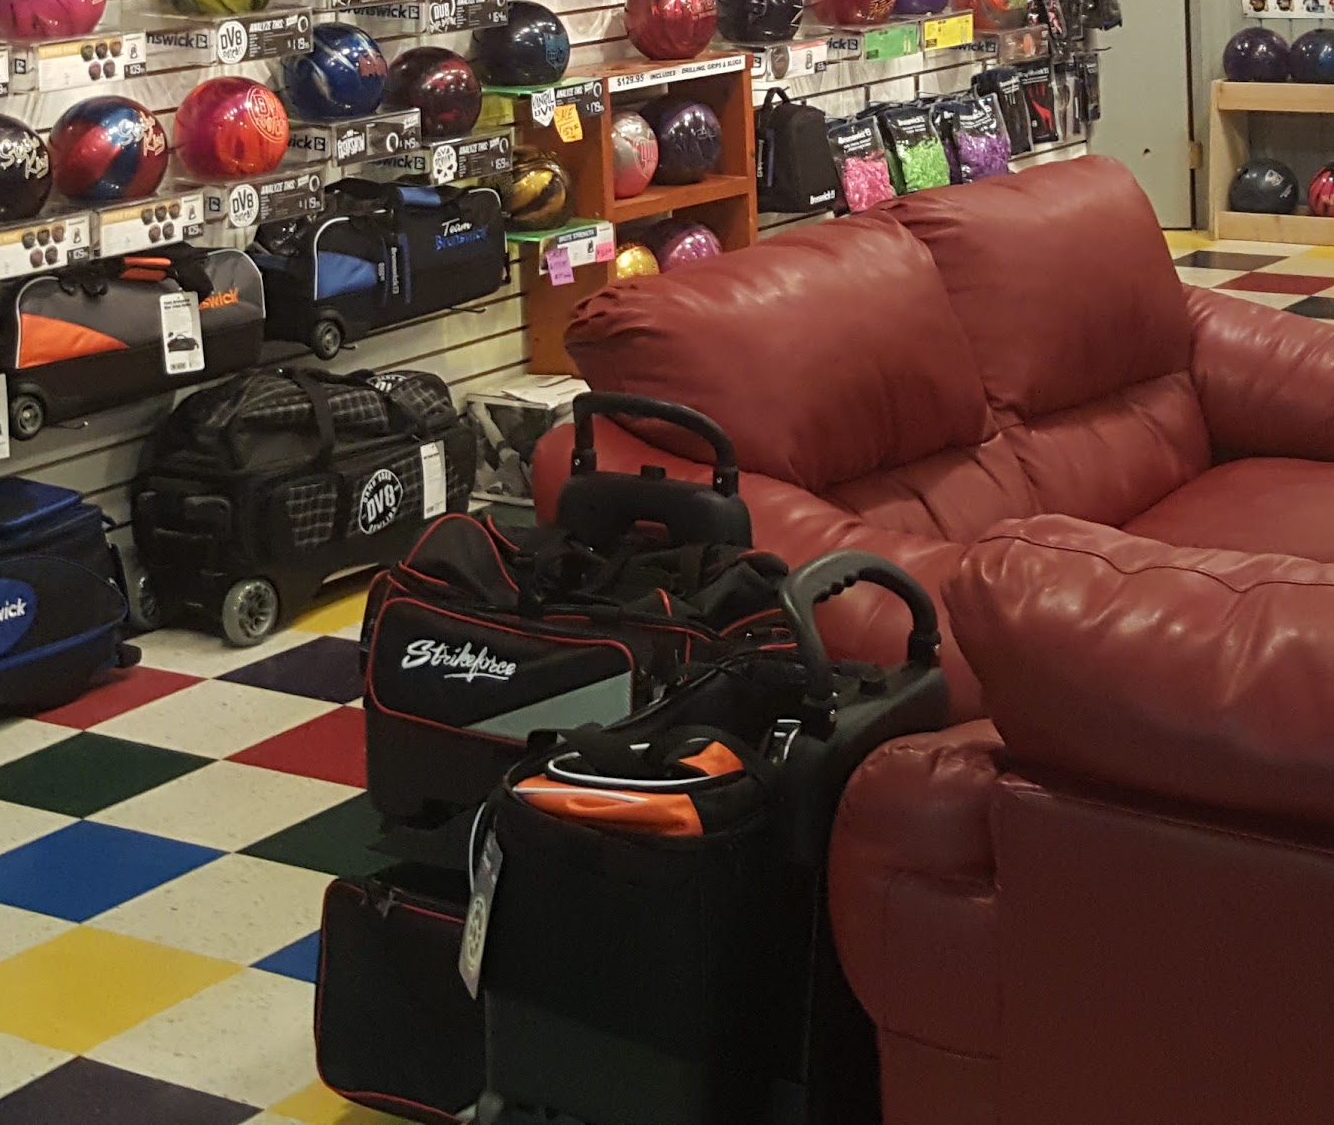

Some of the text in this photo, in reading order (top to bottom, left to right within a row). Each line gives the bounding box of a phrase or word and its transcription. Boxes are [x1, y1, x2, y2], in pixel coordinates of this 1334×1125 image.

[146, 32, 193, 48] nswick
[617, 73, 645, 87] $129.95
[442, 217, 472, 235] Team
[199, 287, 240, 310] swick
[402, 639, 517, 681] Strikeforce
